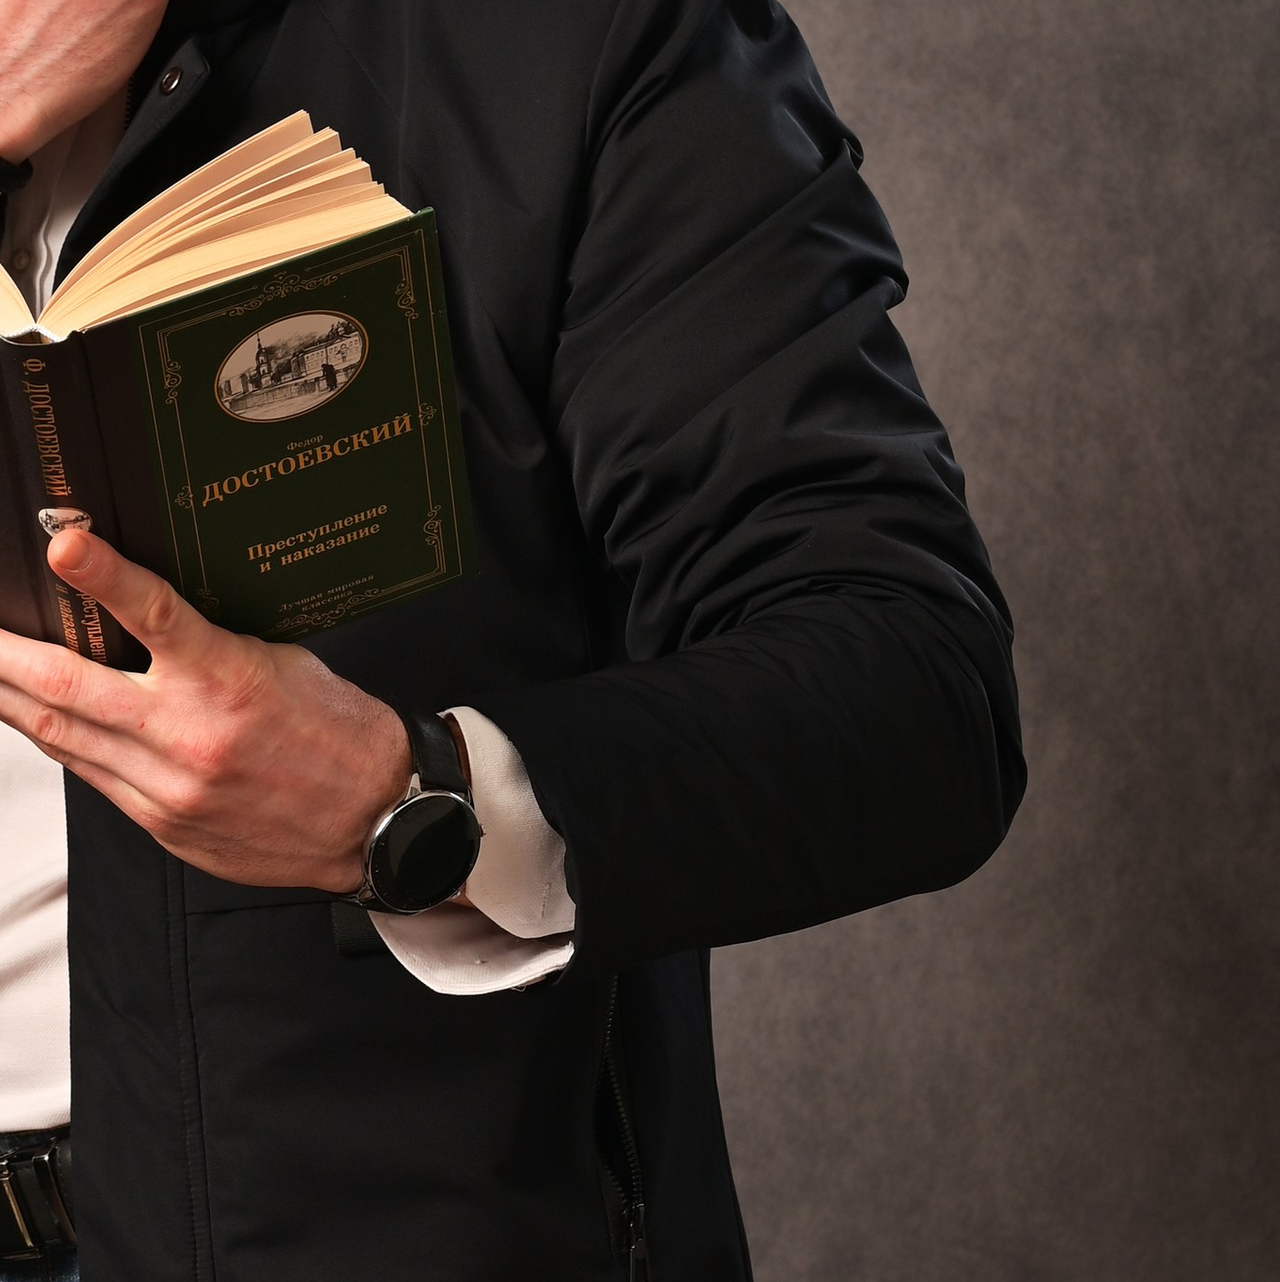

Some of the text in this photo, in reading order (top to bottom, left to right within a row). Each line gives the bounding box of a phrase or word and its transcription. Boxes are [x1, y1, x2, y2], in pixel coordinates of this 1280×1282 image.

[22, 358, 72, 497] Ф. ДОСТОЕВСКИЙ
[286, 434, 324, 452] Федор
[202, 413, 413, 507] ДОСТОЕВСКИЙ
[247, 504, 388, 561] Преступление
[259, 523, 380, 573] и наказание
[278, 574, 375, 613] Лучшая мировая
[301, 589, 353, 612] классика
[58, 597, 80, 651] наказан
[76, 592, 107, 663] реступлени
